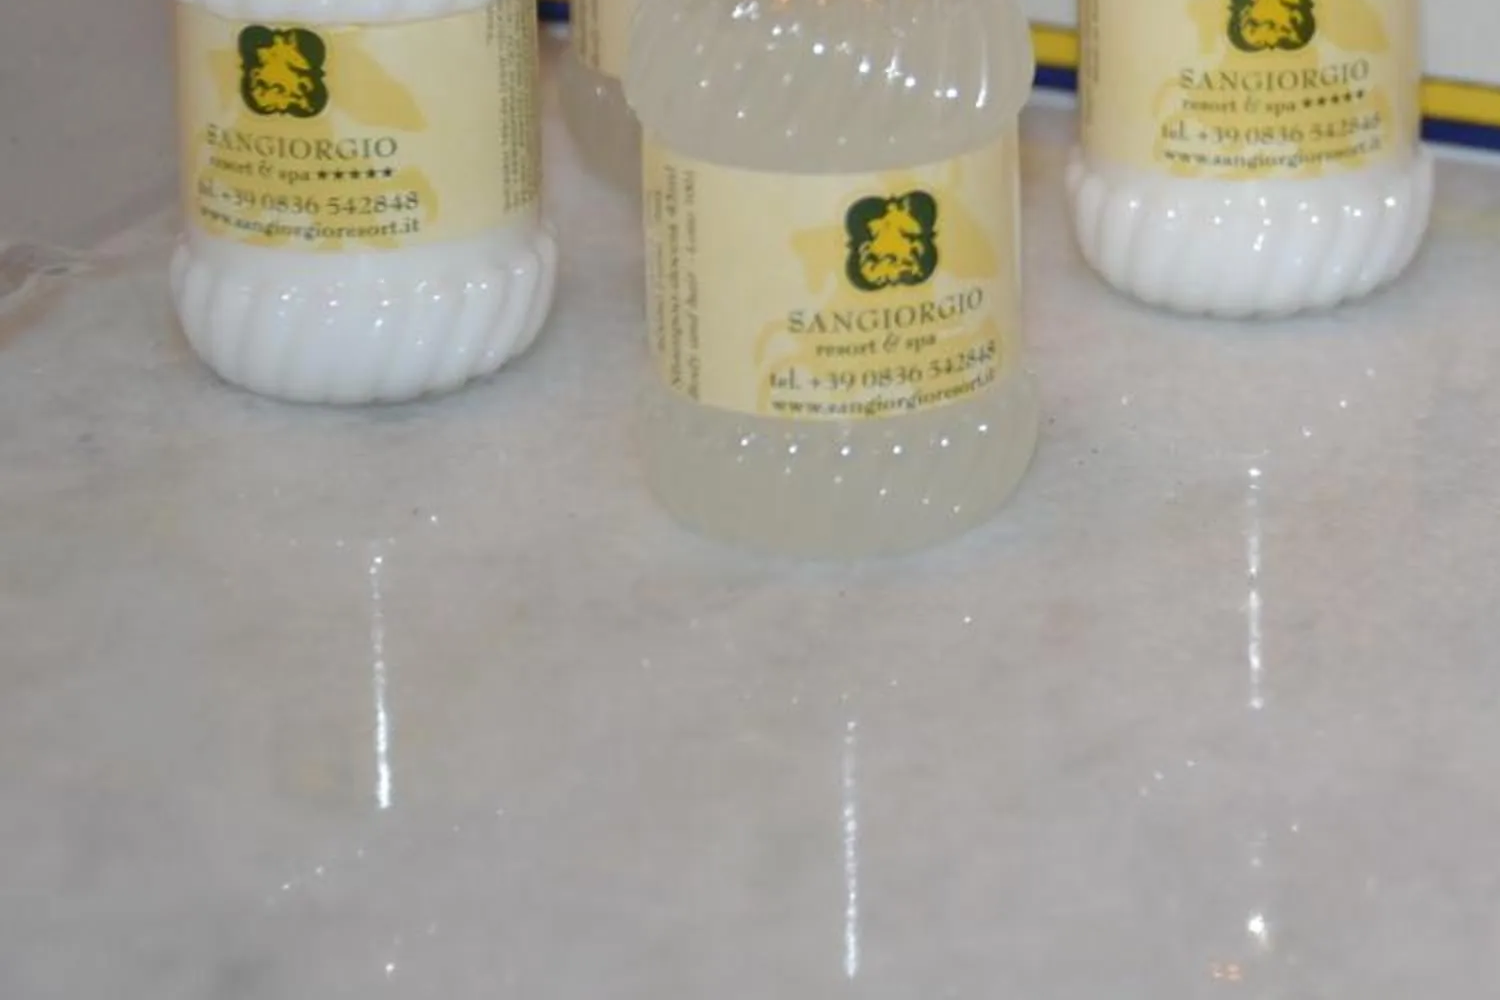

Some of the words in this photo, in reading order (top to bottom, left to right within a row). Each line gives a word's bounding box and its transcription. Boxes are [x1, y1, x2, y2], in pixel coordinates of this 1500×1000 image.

[1179, 58, 1370, 93] SANGIORGIO
[207, 122, 398, 161] SANGIORGIO
[279, 168, 310, 185] spa
[326, 190, 418, 215] 542848
[787, 286, 984, 334] SANGIORGIO
[815, 339, 876, 358] resort
[905, 333, 936, 354] spa
